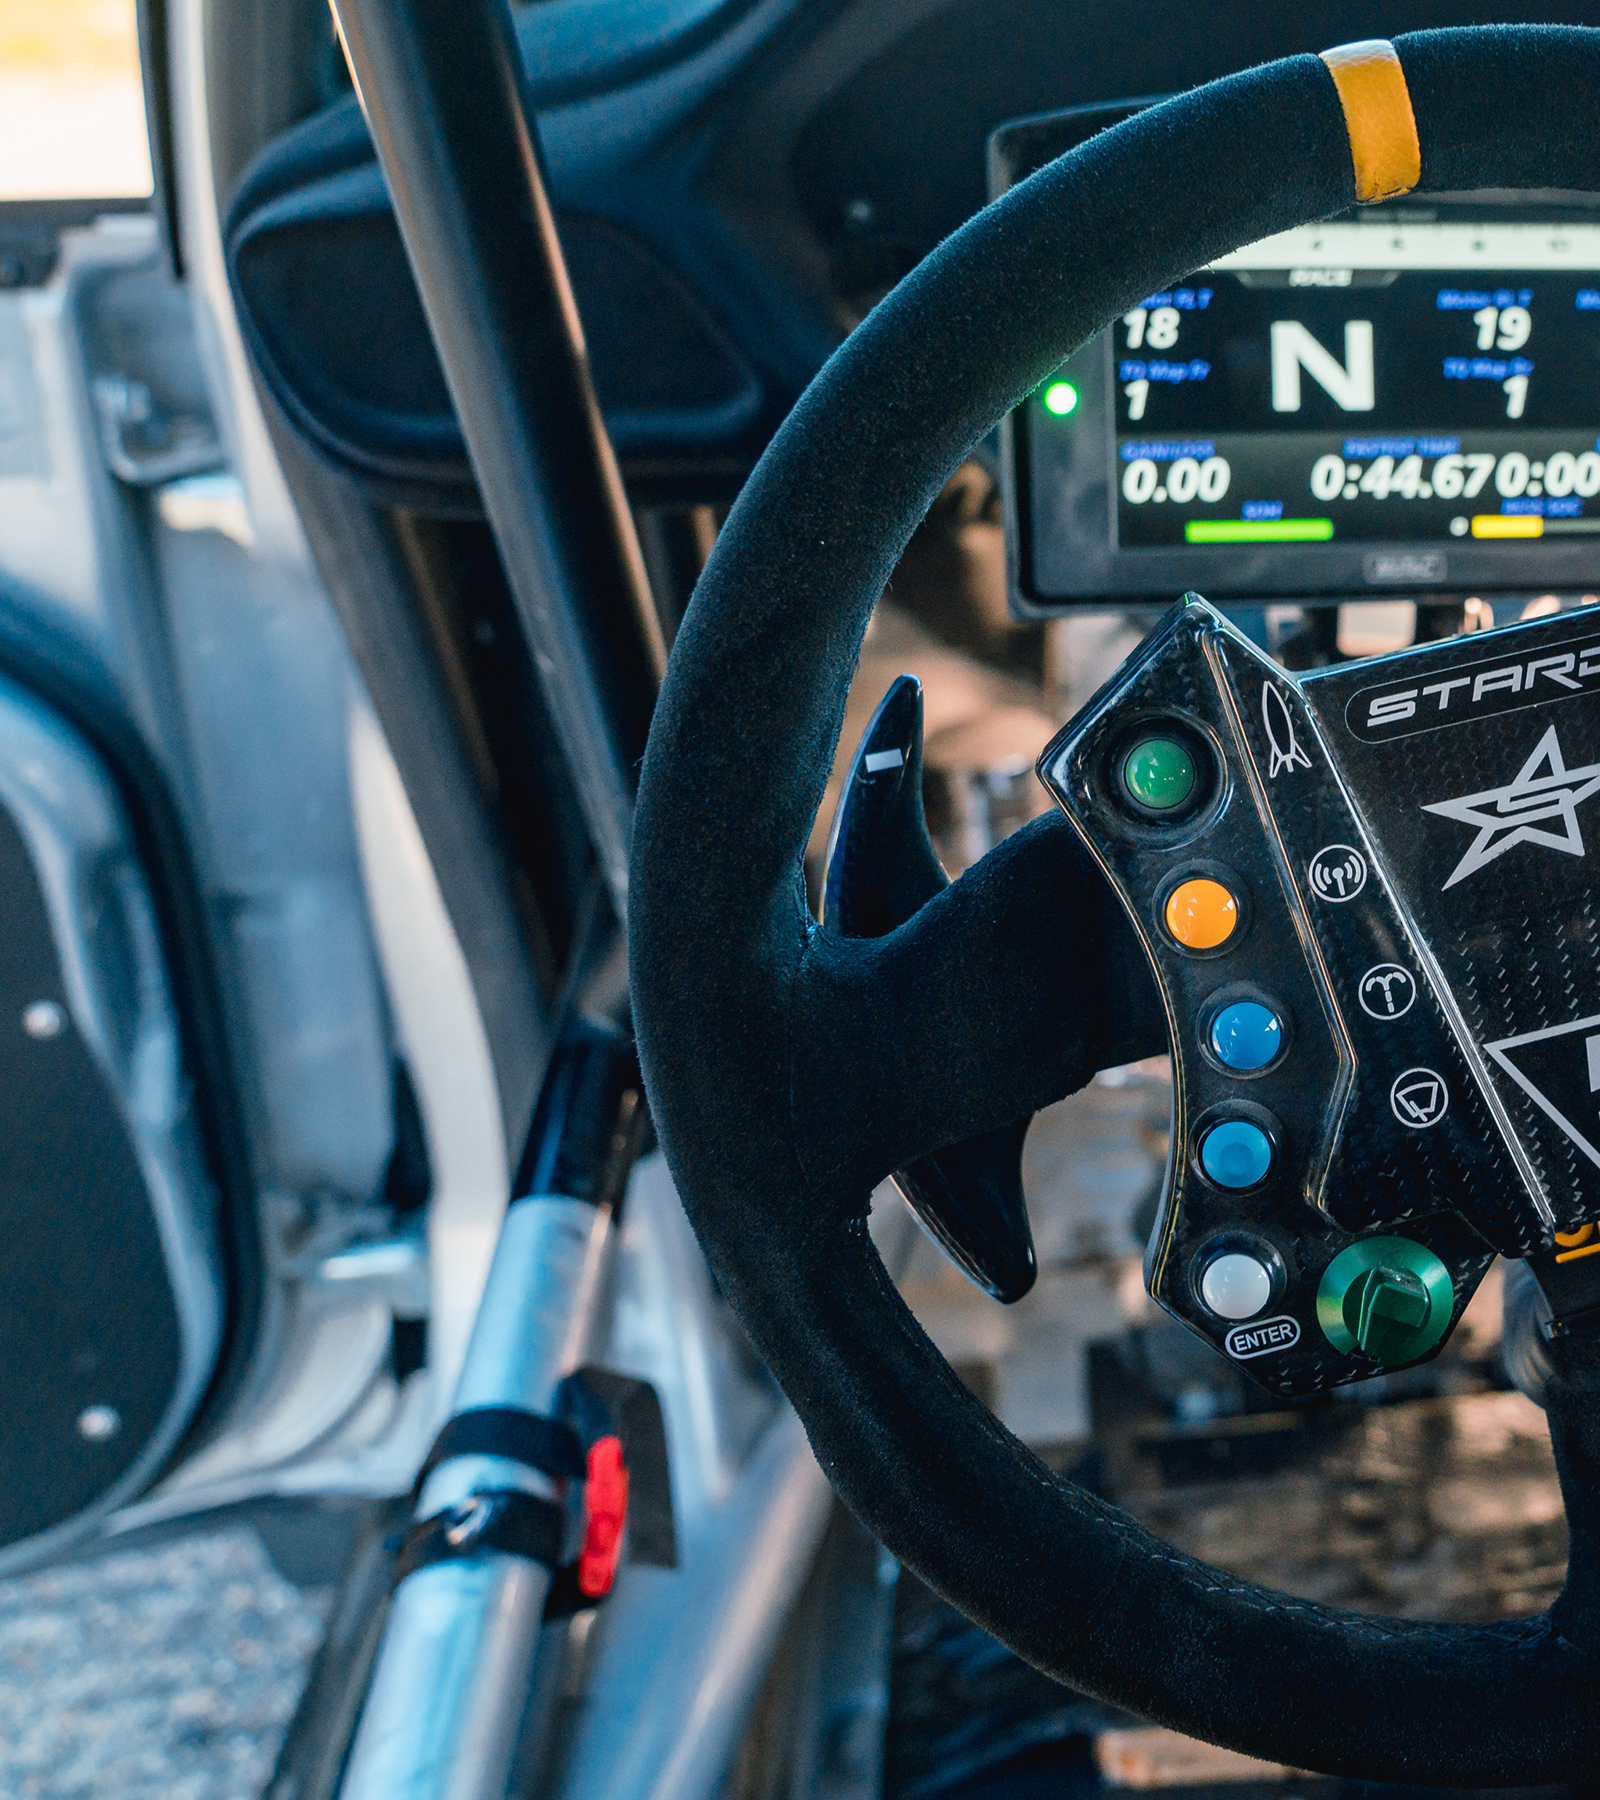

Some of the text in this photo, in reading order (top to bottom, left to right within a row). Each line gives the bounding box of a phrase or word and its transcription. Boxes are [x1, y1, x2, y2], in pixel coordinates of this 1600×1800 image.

[1122, 306, 1181, 350] 18
[1472, 305, 1533, 351] 19
[1270, 319, 1375, 412] N
[1124, 378, 1150, 421] 1
[1502, 374, 1530, 419] 1
[1122, 456, 1231, 504] 0.00
[1310, 453, 1496, 501] 0:44.67
[1233, 1323, 1295, 1352] ENTER
